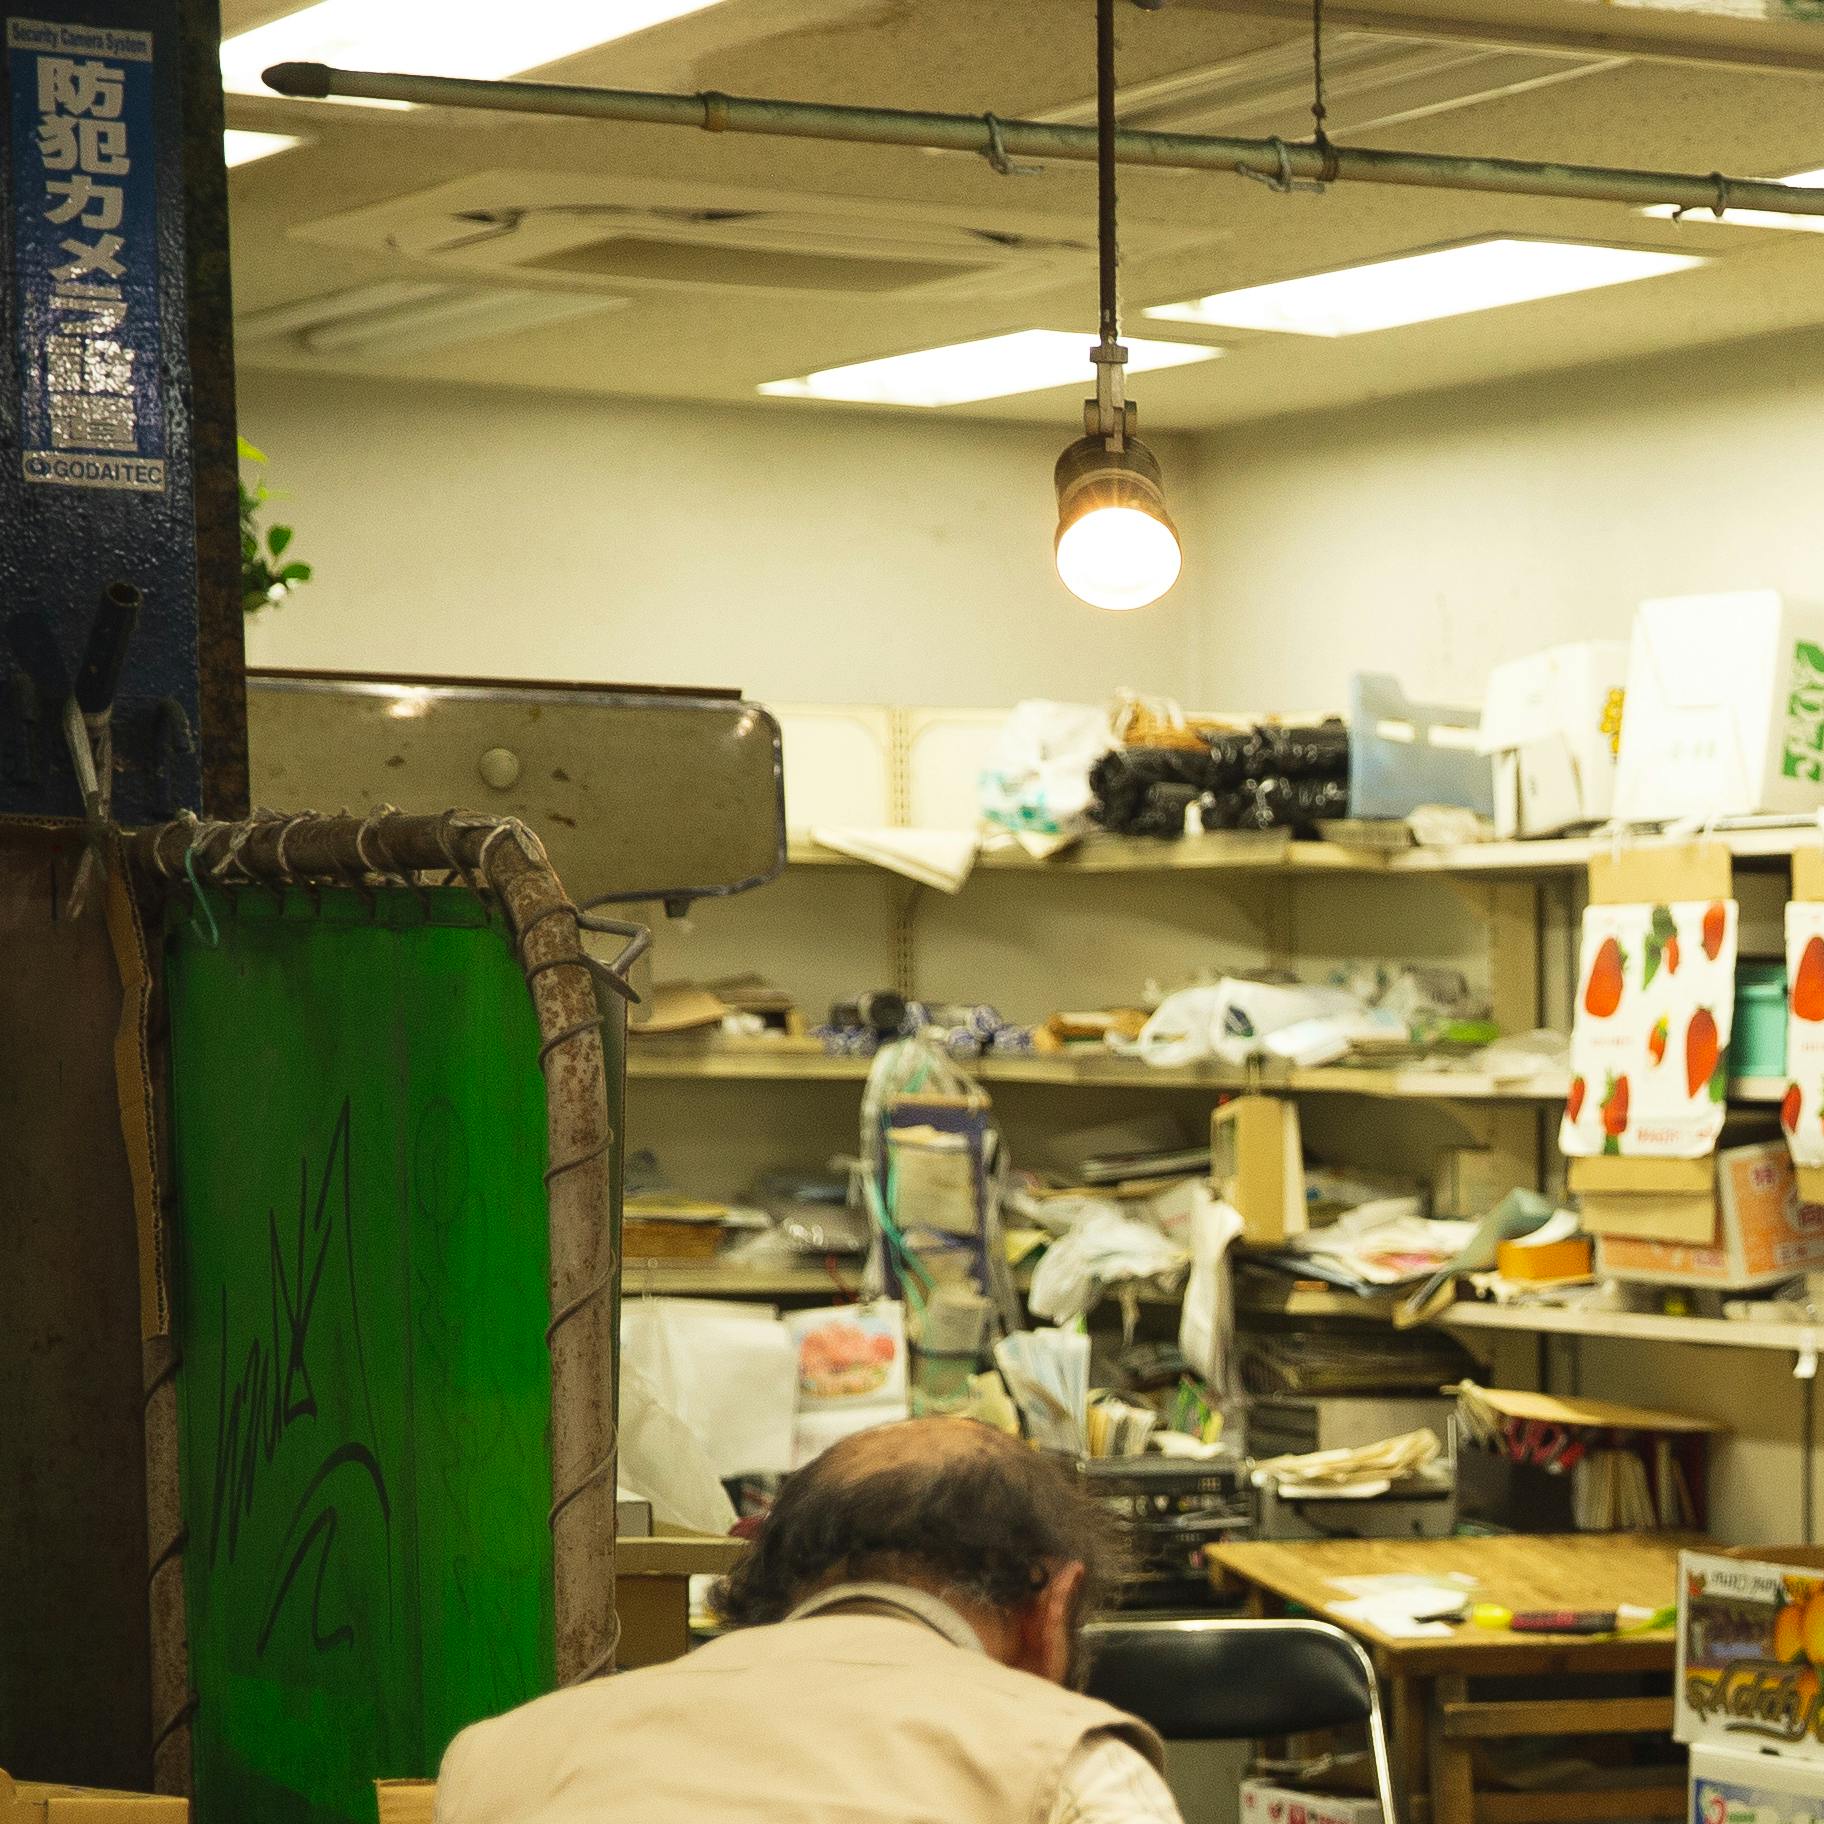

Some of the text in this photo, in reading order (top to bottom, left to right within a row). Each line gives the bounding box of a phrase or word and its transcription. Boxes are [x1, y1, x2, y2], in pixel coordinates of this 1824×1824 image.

[37, 56, 137, 452] 防犯カメラ設置
[54, 461, 163, 484] GODAITEC
